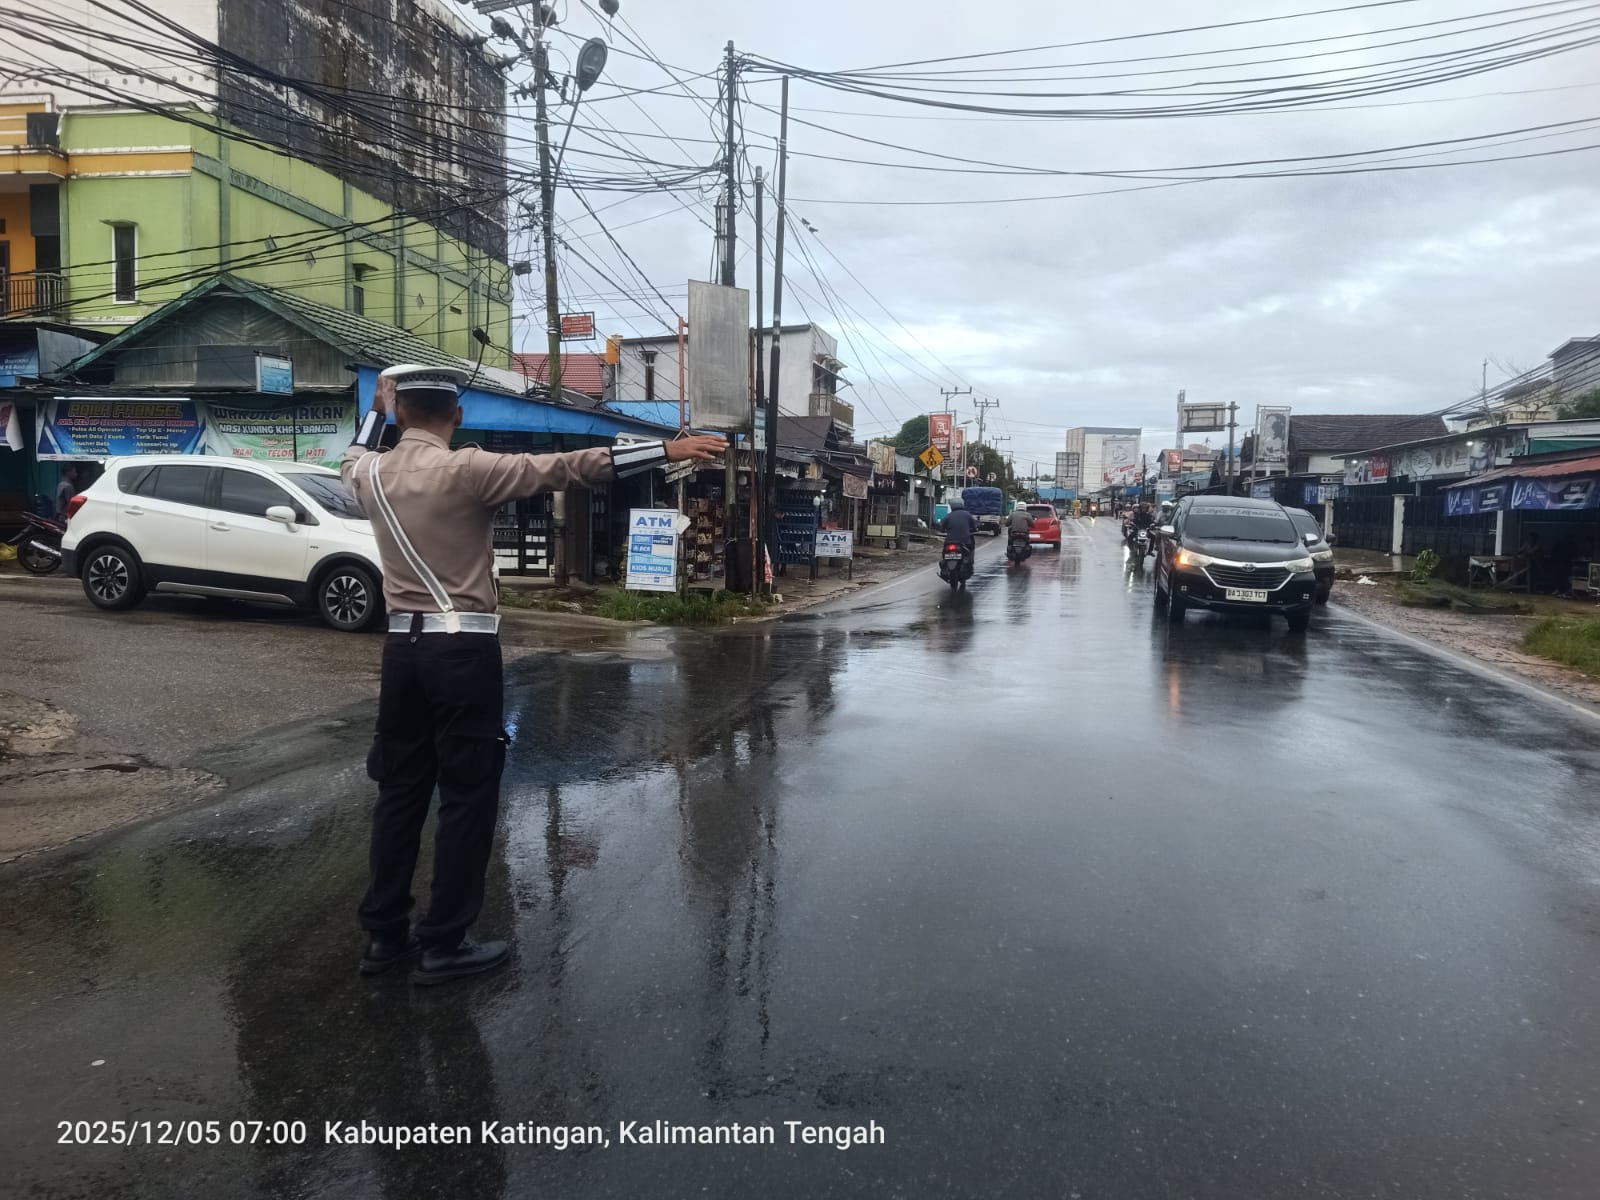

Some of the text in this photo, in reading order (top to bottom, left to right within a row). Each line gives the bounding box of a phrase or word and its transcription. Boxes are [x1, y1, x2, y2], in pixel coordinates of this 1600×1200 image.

[220, 423, 336, 434] NASI KUNING KHAS BANJAR
[636, 516, 672, 528] ATM
[822, 534, 847, 542] ATM
